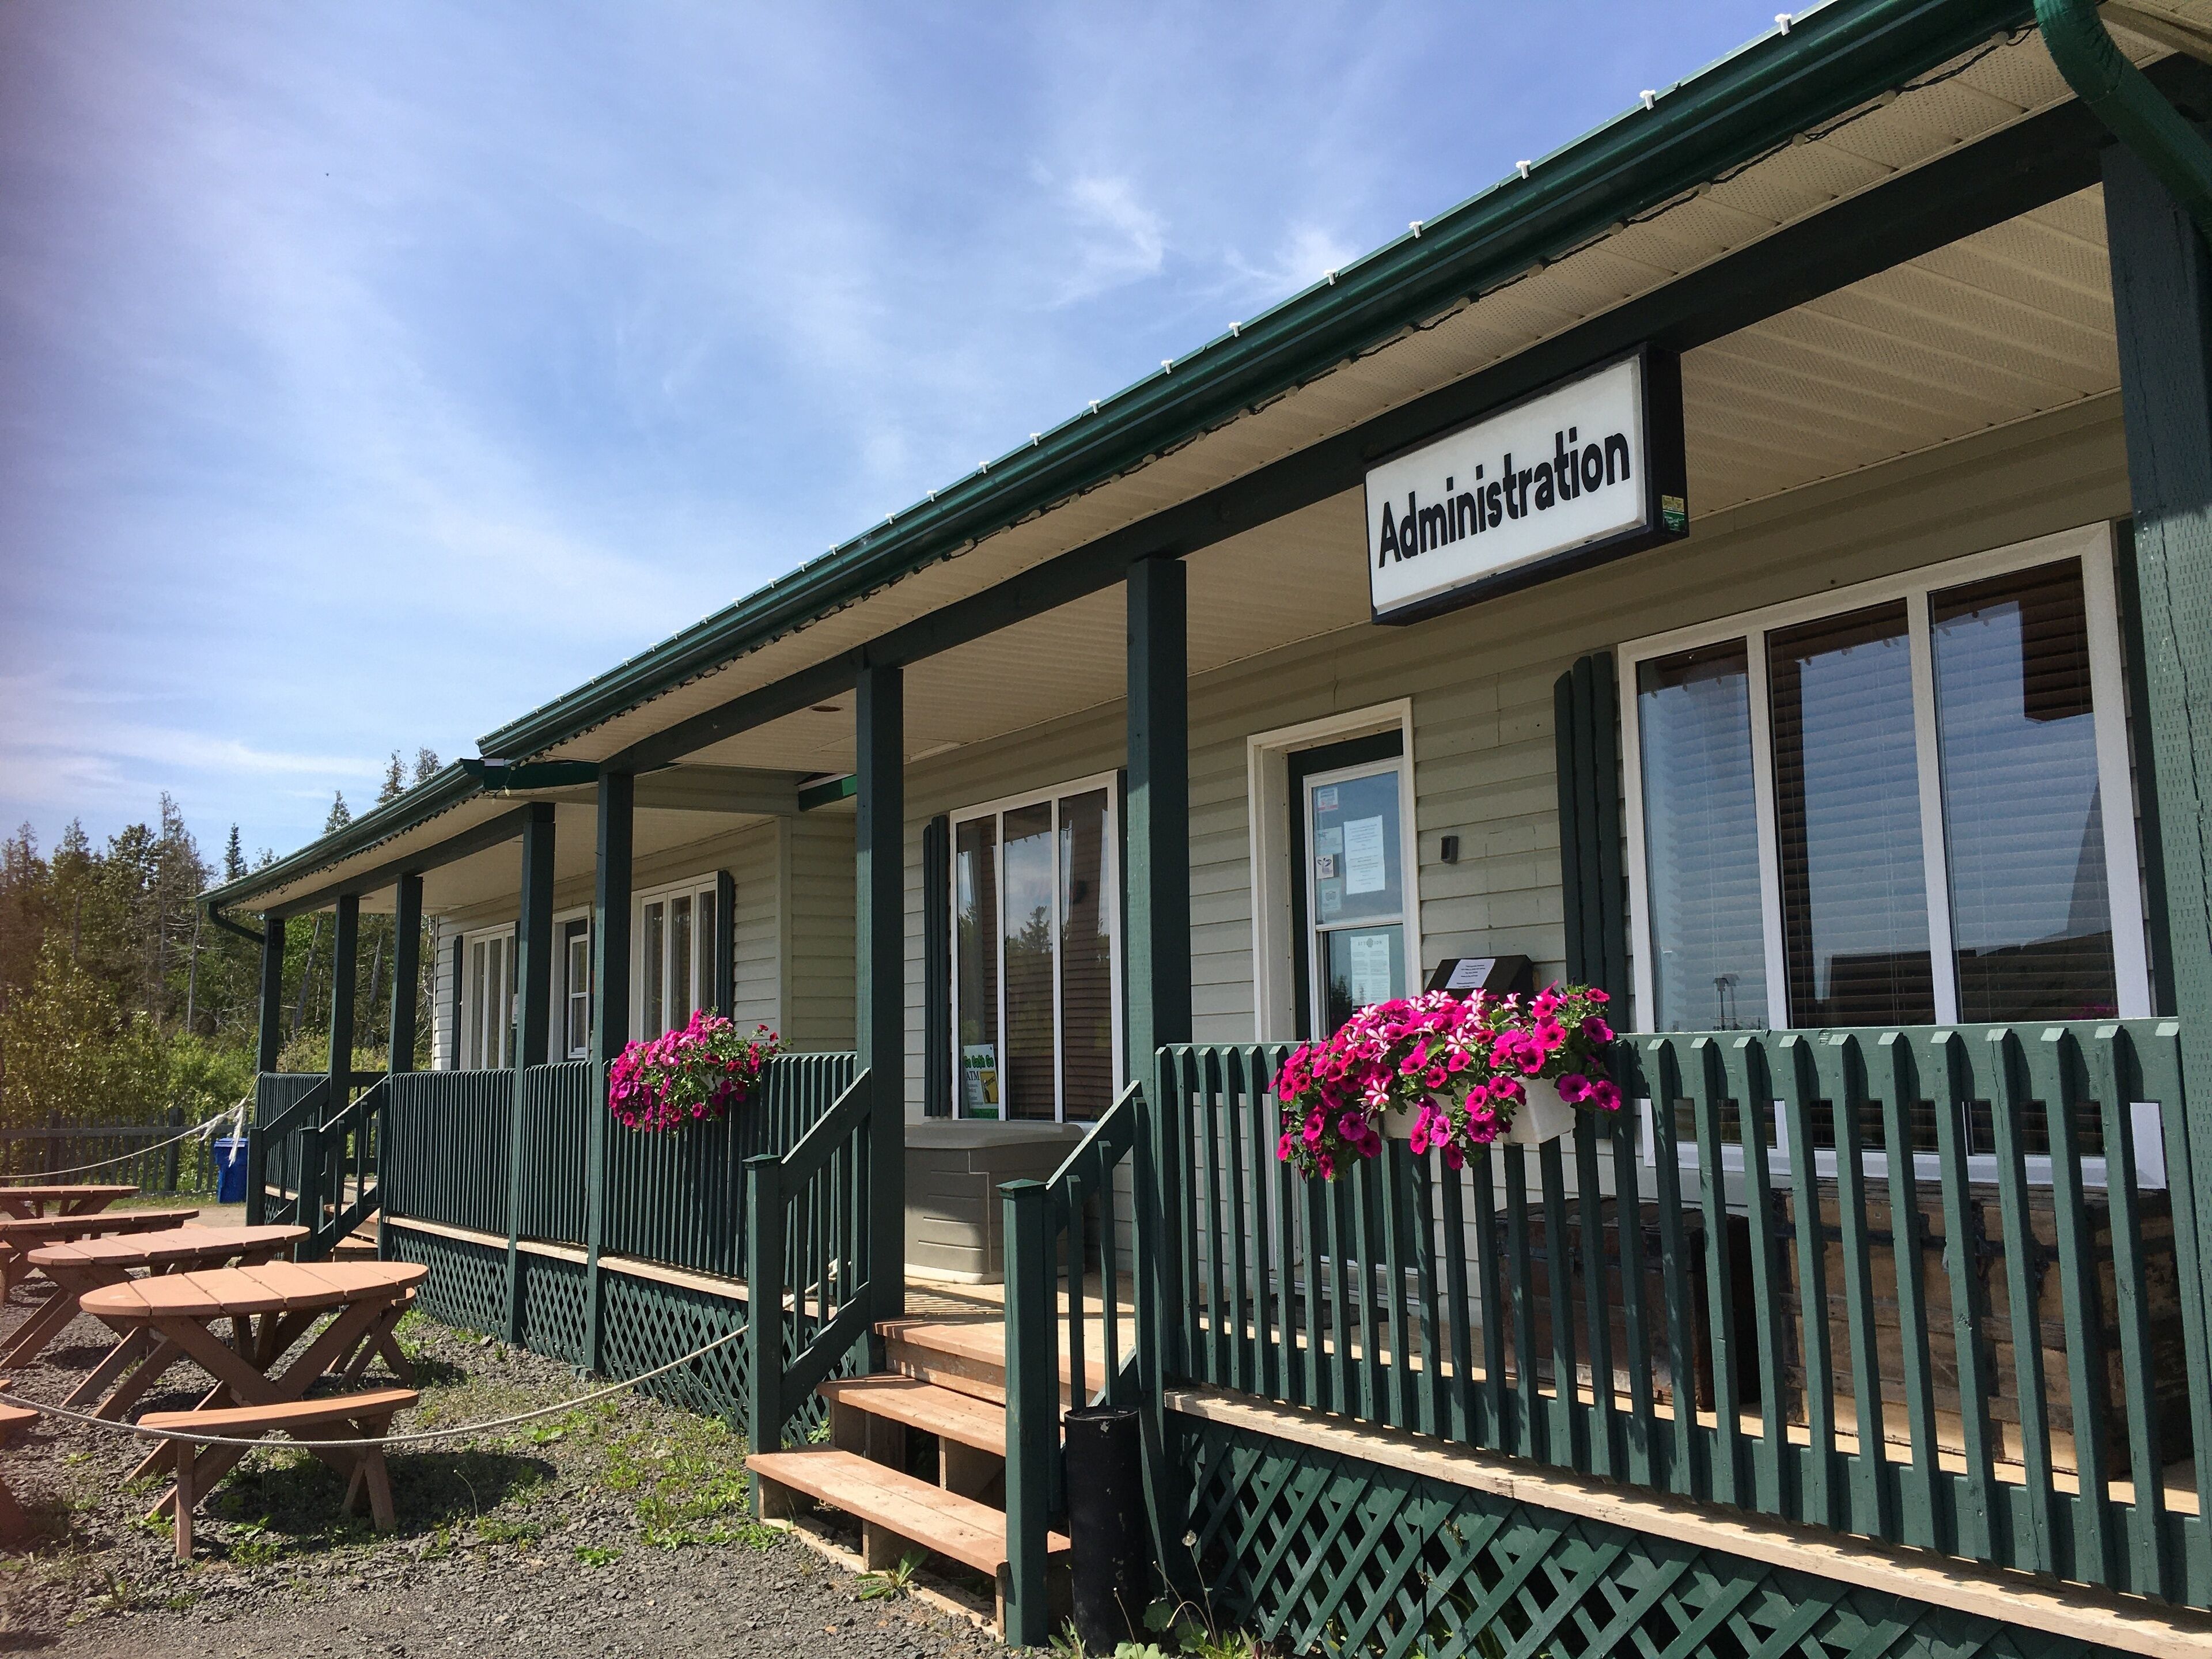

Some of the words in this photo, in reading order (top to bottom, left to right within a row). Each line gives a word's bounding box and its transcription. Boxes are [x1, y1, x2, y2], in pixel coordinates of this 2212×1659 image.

[1378, 426, 1630, 569] Administration
[985, 1055, 994, 1068] Go
[966, 1071, 980, 1081] ATM
